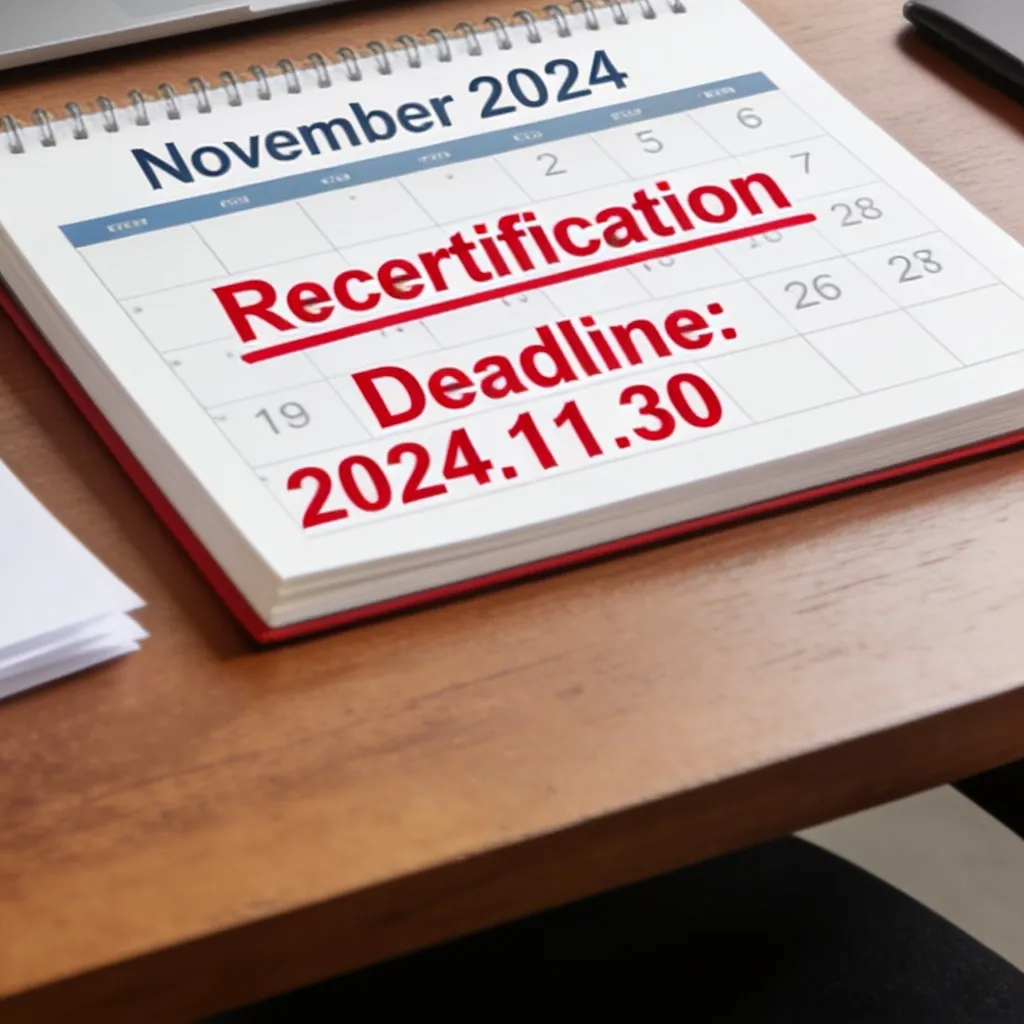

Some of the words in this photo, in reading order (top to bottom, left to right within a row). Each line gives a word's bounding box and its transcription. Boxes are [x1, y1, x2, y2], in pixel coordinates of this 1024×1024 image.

[131, 94, 456, 190] November
[468, 49, 628, 119] 2024
[536, 153, 567, 176] 2
[634, 129, 664, 154] 5
[736, 107, 763, 129] 6
[789, 152, 810, 174] 7
[830, 197, 883, 227] 28
[212, 172, 792, 343] Recertification
[784, 274, 842, 310] 26
[352, 302, 738, 429] Deadline:
[254, 401, 311, 435] 19
[286, 372, 723, 529] 2024.11.30
